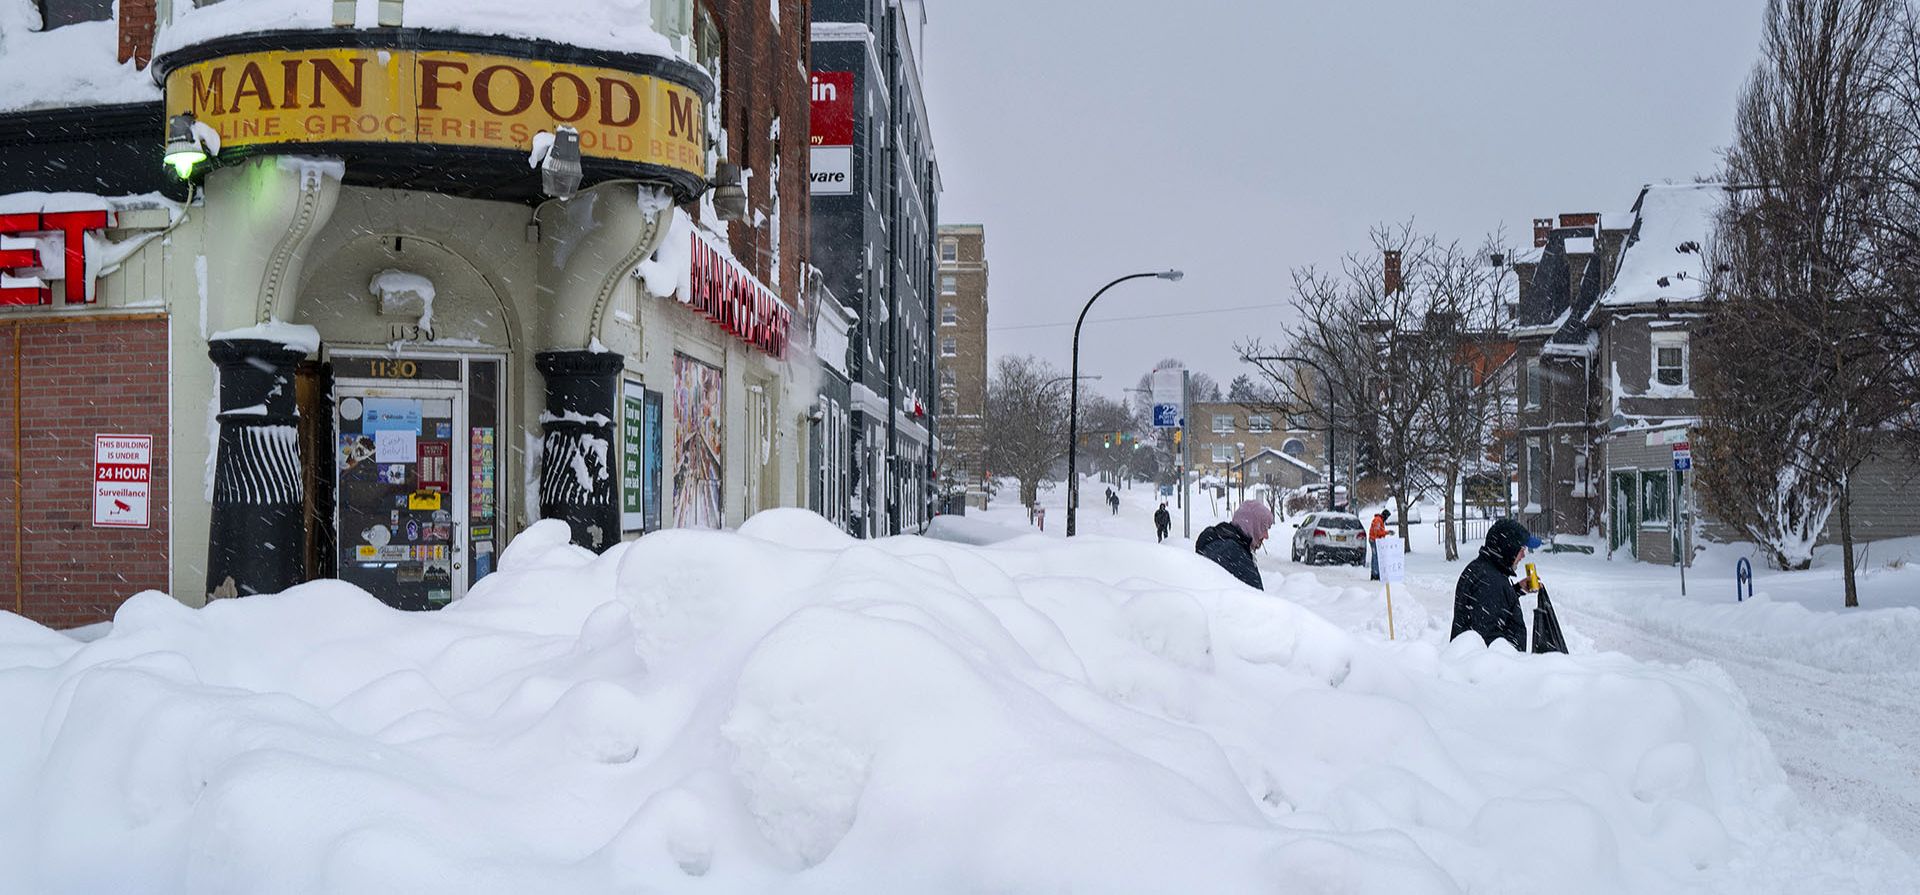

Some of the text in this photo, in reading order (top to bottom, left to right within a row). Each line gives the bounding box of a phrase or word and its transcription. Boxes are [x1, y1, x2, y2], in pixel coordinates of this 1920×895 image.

[191, 57, 368, 119] MAIN
[418, 59, 641, 127] FOOD
[811, 76, 837, 101] in
[219, 113, 695, 164] LINE GROCERIES OLD BEER
[0, 210, 108, 305] ET
[691, 230, 724, 326] MAIN
[725, 259, 757, 342] FOOD
[391, 325, 435, 341] 1130
[370, 359, 417, 378] 1130
[1162, 404, 1177, 415] 22
[99, 441, 149, 450] THIS BUILDING
[115, 452, 140, 460] UNDER
[98, 467, 147, 480] 24 HOUR
[98, 488, 146, 498] Surveillance
